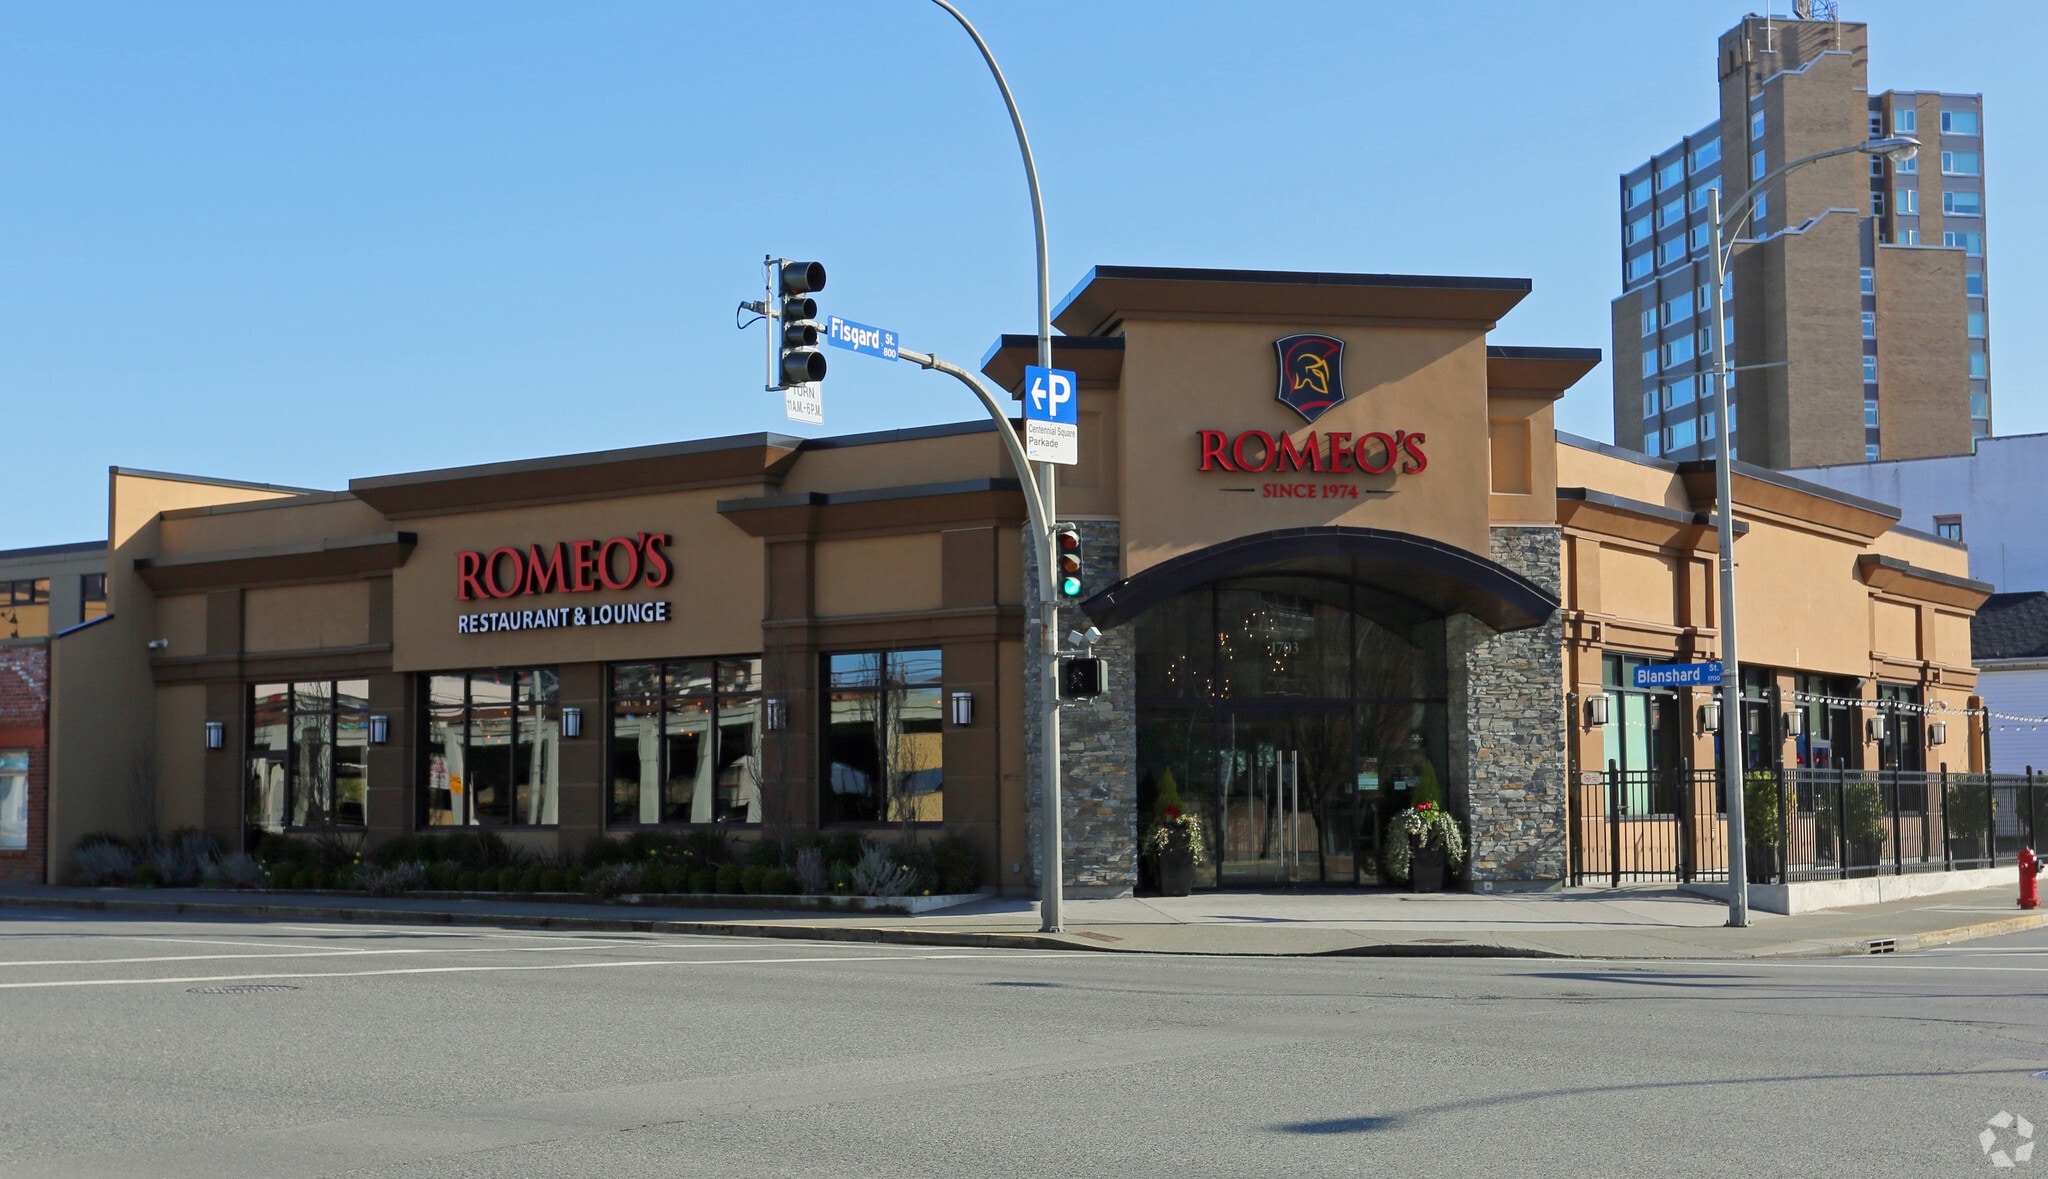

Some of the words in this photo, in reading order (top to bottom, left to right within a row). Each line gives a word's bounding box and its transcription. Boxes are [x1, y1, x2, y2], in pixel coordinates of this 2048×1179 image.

[831, 317, 880, 350] Fisgard
[885, 333, 895, 346] St.
[883, 347, 897, 359] 800
[793, 386, 815, 399] TURN
[1048, 374, 1071, 417] P
[1028, 423, 1056, 436] Centennial
[1057, 427, 1075, 439] Square
[1028, 436, 1059, 449] Parkade
[1197, 430, 1428, 475] ROMEO'S
[1263, 483, 1317, 499] SINCE
[1322, 484, 1359, 499] 1974
[454, 532, 671, 601] ROMEO'S
[458, 607, 570, 634] RESTAURANT
[573, 606, 587, 626] &
[590, 601, 669, 625] LOUNGE
[1271, 641, 1299, 654] 1703
[1637, 667, 1701, 684] Blanshard
[1708, 664, 1719, 672] St.
